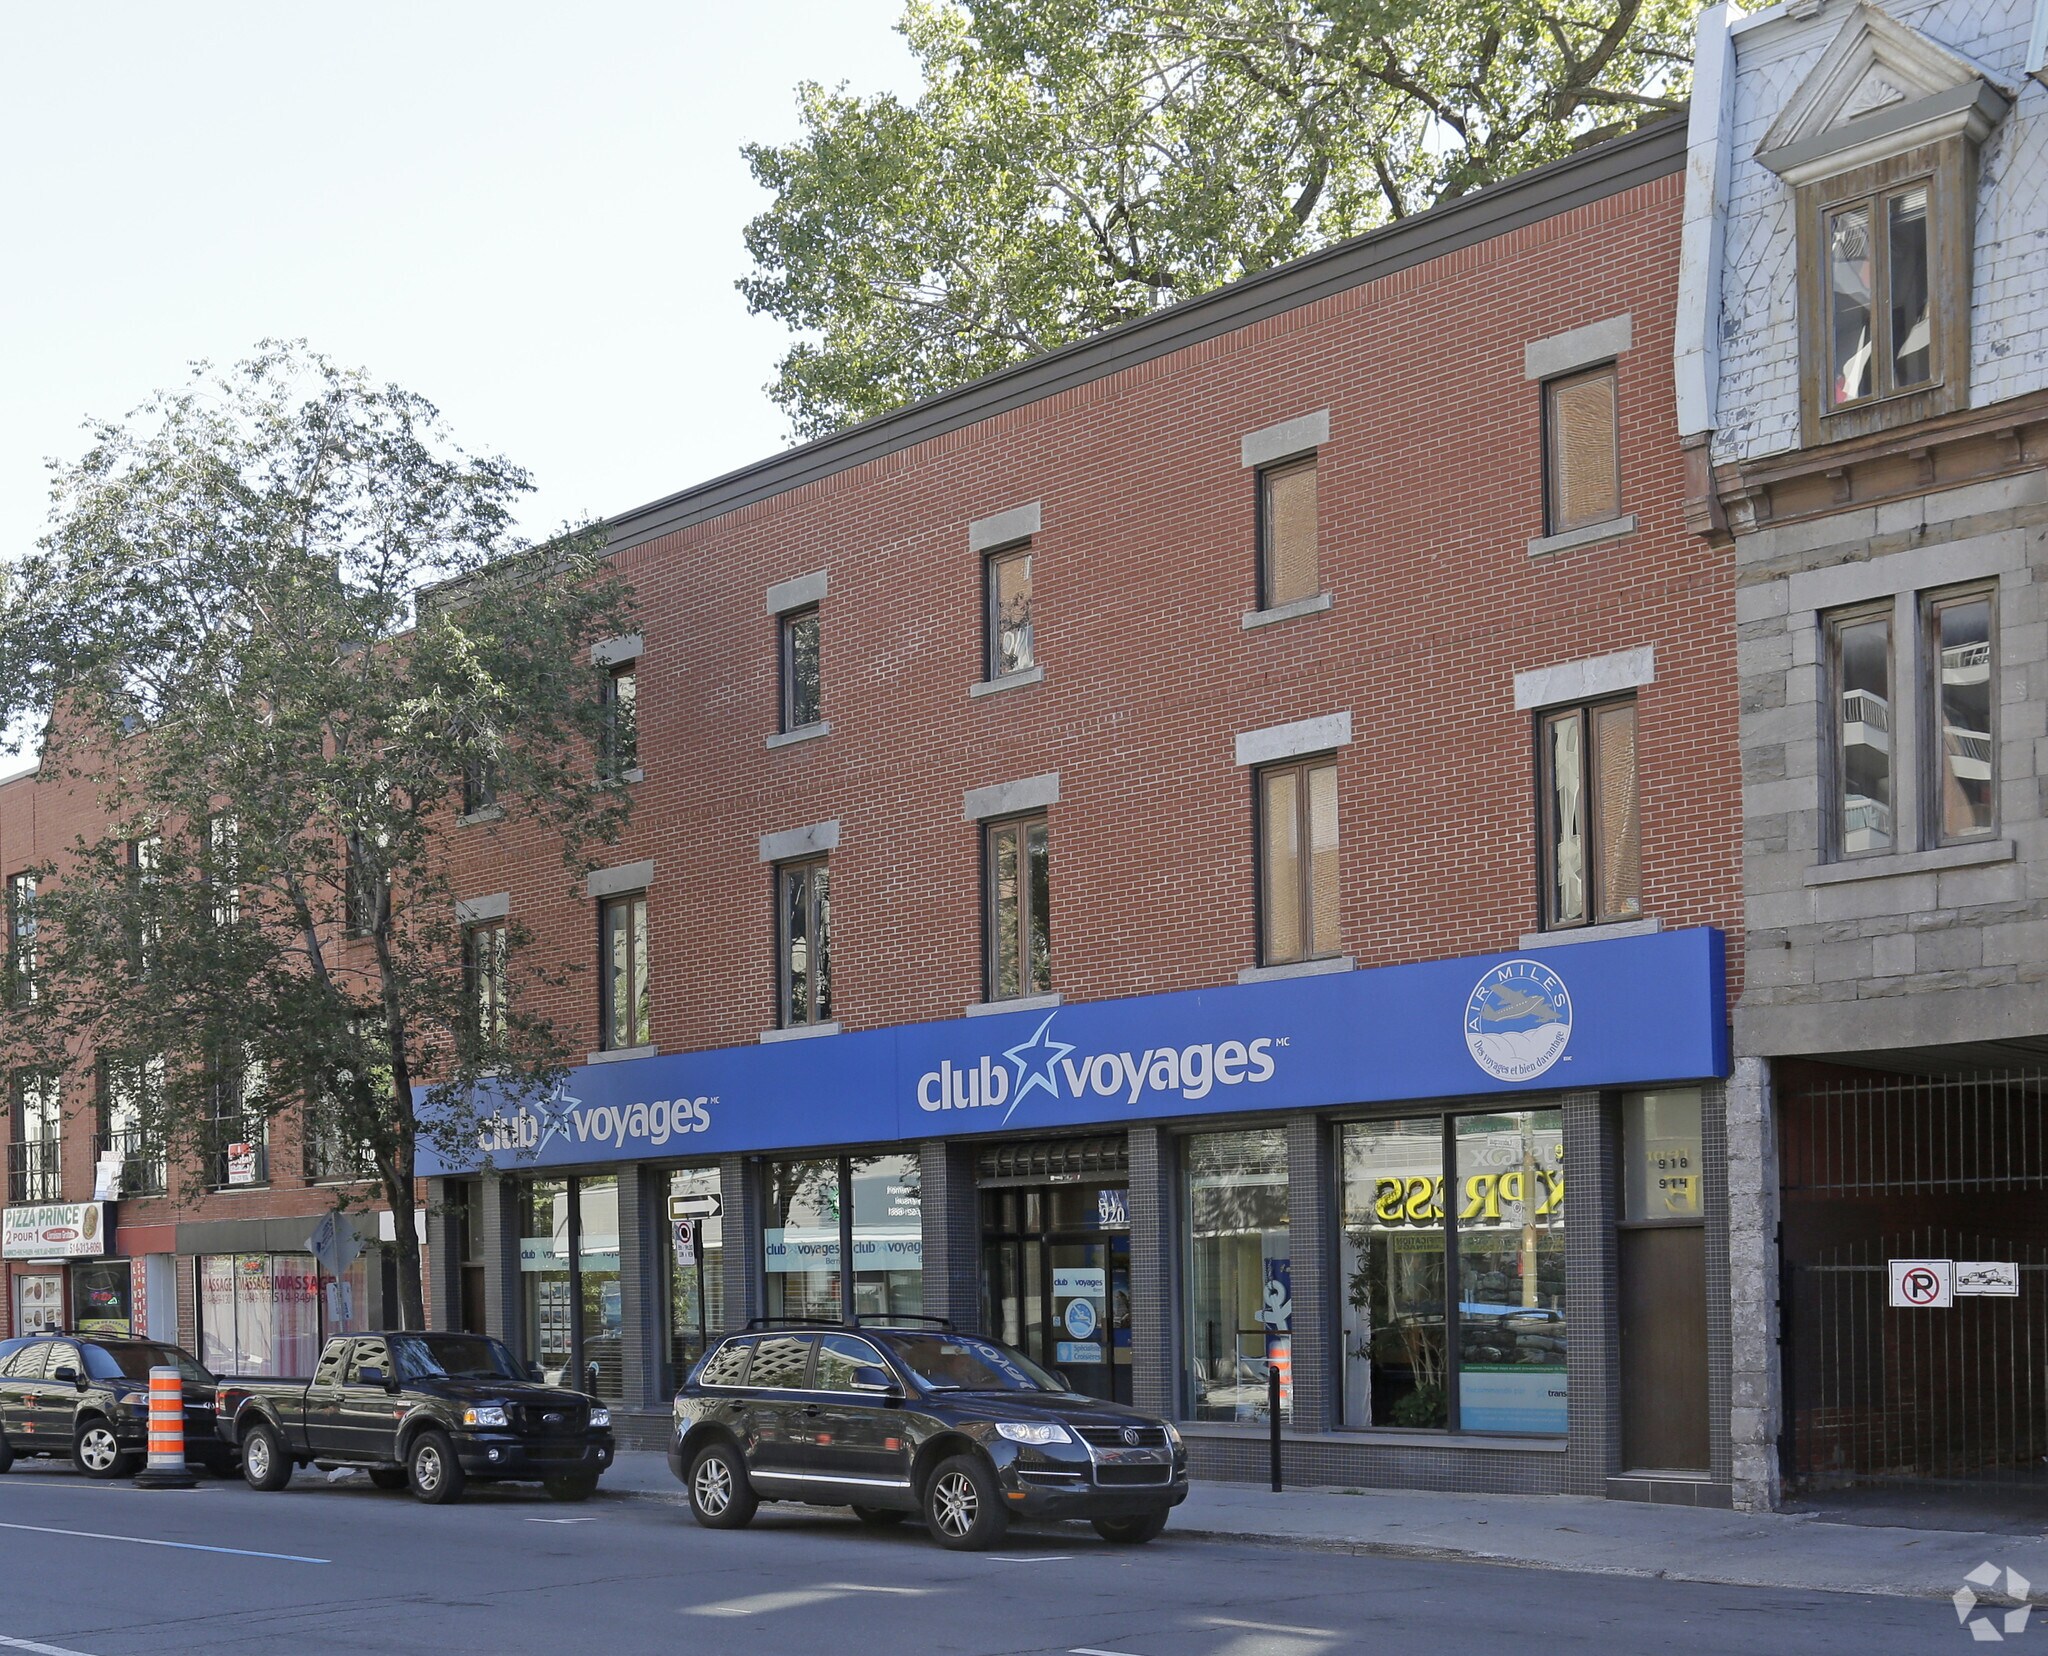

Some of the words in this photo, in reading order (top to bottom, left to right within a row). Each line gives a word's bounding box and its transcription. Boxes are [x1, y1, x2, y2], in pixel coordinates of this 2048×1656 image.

[1469, 986, 1489, 1031] AIR
[1498, 964, 1566, 1008] MILES
[1474, 1040, 1484, 1057] Des
[1482, 1054, 1509, 1075] voyages
[1510, 1064, 1518, 1075] et
[1519, 1062, 1536, 1075] bien
[1536, 1031, 1564, 1067] davantage
[917, 1055, 1009, 1112] club
[1061, 1038, 1275, 1104] voyages
[1275, 1036, 1290, 1047] MC
[573, 1096, 711, 1148] voyages
[1658, 1158, 1688, 1169] 918
[1659, 1178, 1687, 1188] 914
[6, 1209, 36, 1228] PIZZA
[38, 1206, 80, 1226] PRINCE
[1101, 1207, 1125, 1224] 920
[5, 1230, 12, 1245] 2
[13, 1232, 34, 1242] POUR
[766, 1243, 786, 1255] club
[798, 1243, 839, 1257] voyages
[853, 1242, 876, 1254] club
[203, 1278, 232, 1292] MASSAGE
[239, 1276, 270, 1290] MASSAGE
